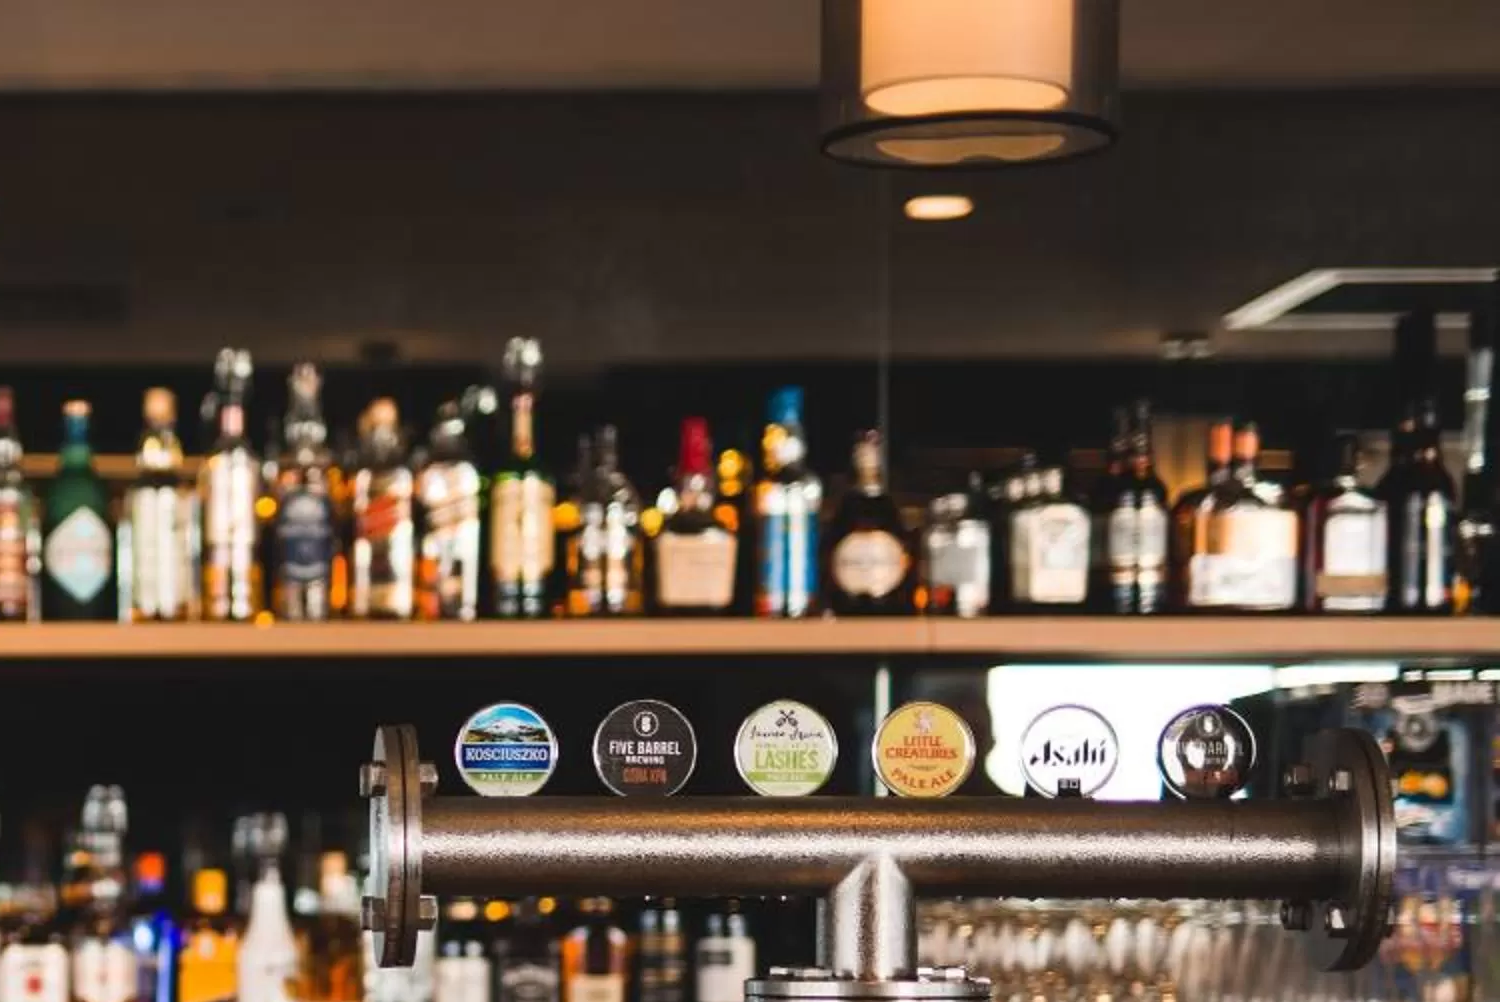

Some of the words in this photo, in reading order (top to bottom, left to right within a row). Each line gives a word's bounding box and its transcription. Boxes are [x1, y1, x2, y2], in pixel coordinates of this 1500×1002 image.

[609, 740, 635, 755] FIVE
[637, 741, 682, 755] BARREL
[903, 735, 943, 747] LITTLE
[465, 747, 548, 762] KOSCIUSZKO
[755, 749, 818, 769] LASHES
[885, 747, 959, 760] CREATURES
[1029, 737, 1107, 766] Asahi
[625, 755, 665, 765] BREWING
[891, 767, 927, 789] PALE
[930, 768, 956, 789] ALE
